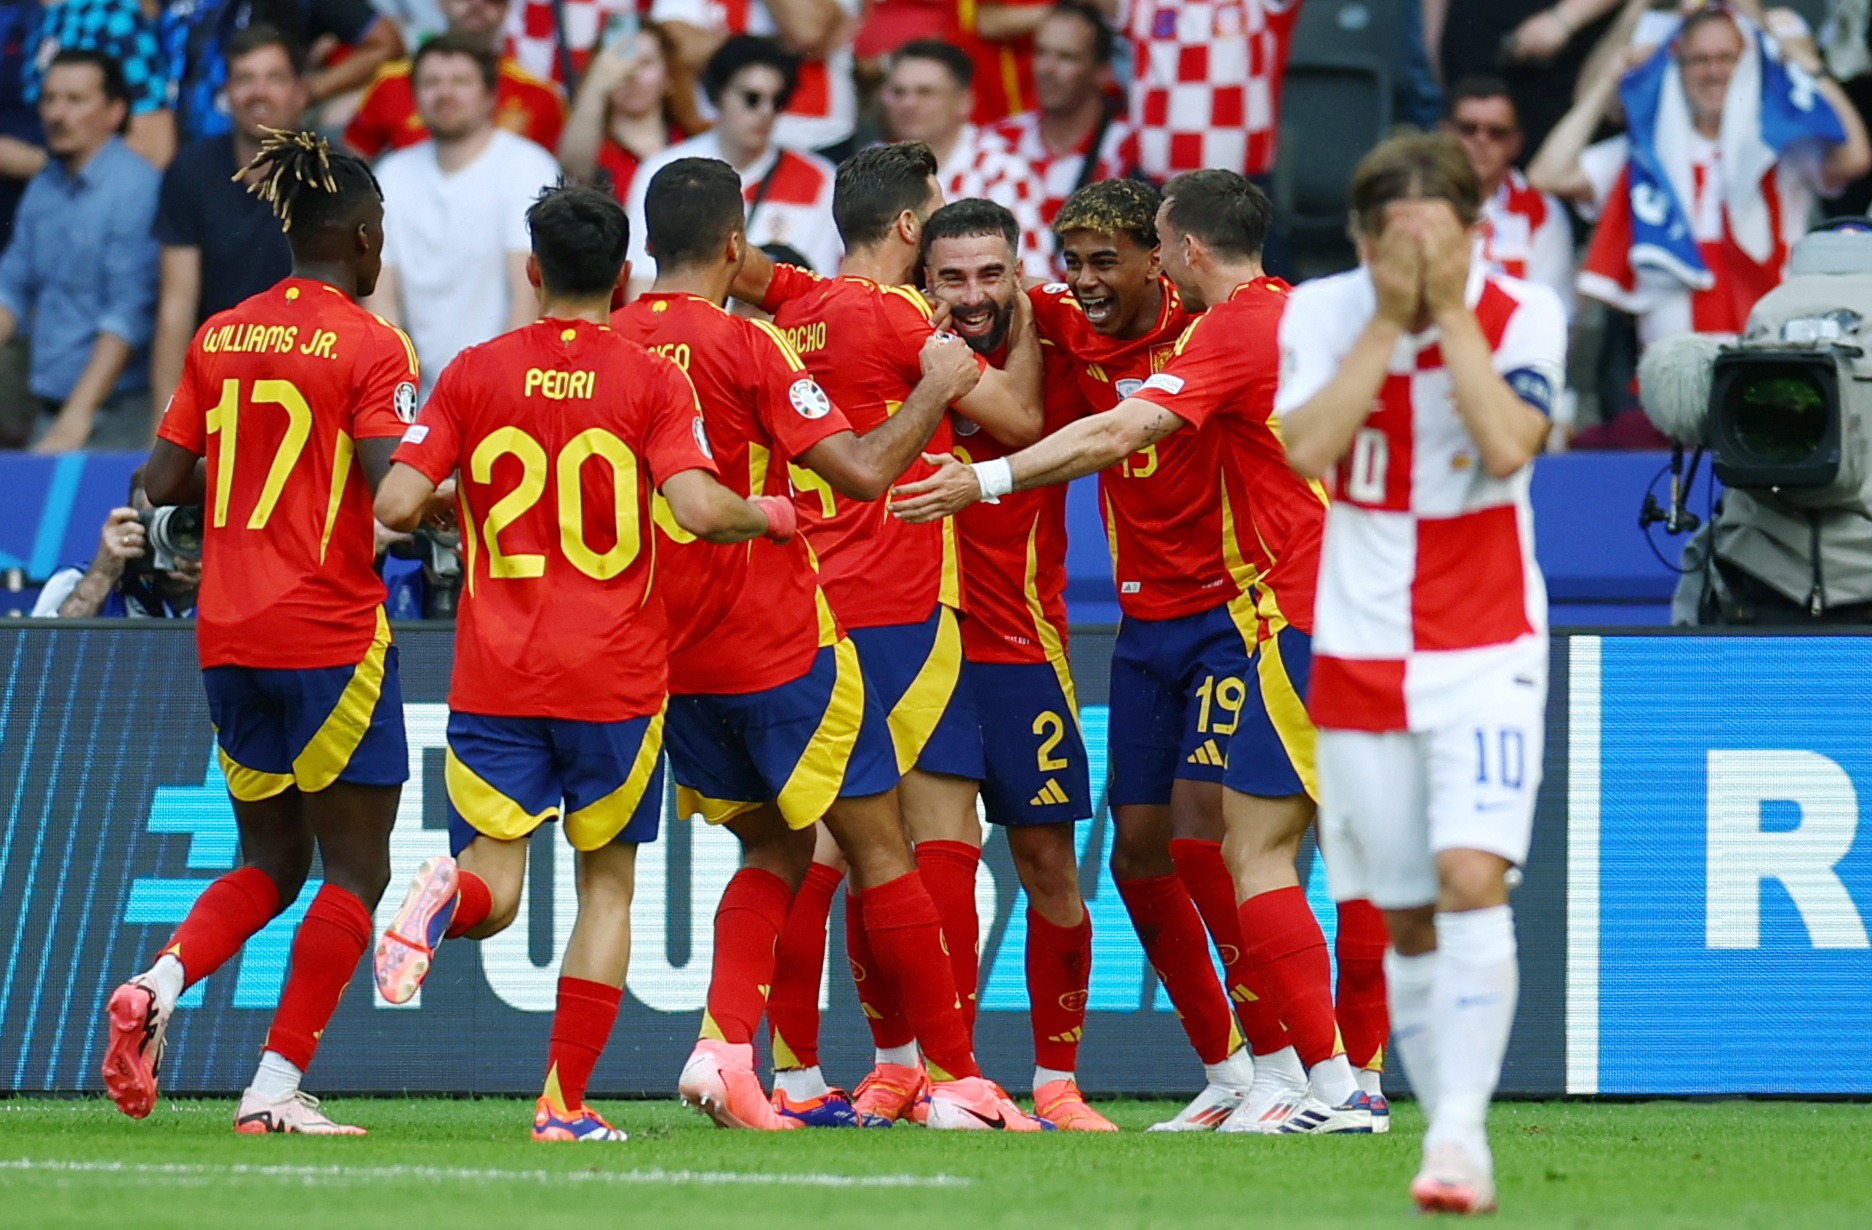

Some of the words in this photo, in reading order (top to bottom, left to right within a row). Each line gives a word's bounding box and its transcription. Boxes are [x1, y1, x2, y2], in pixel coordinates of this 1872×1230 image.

[202, 323, 298, 353] WILLIAMS
[300, 328, 338, 360] JR.
[524, 367, 596, 400] PEDRI
[205, 378, 313, 530] 17
[470, 425, 641, 581] 20
[1195, 675, 1247, 735] 19
[1032, 710, 1068, 772] 2
[1474, 727, 1525, 790] 10
[1705, 749, 1871, 949] R
